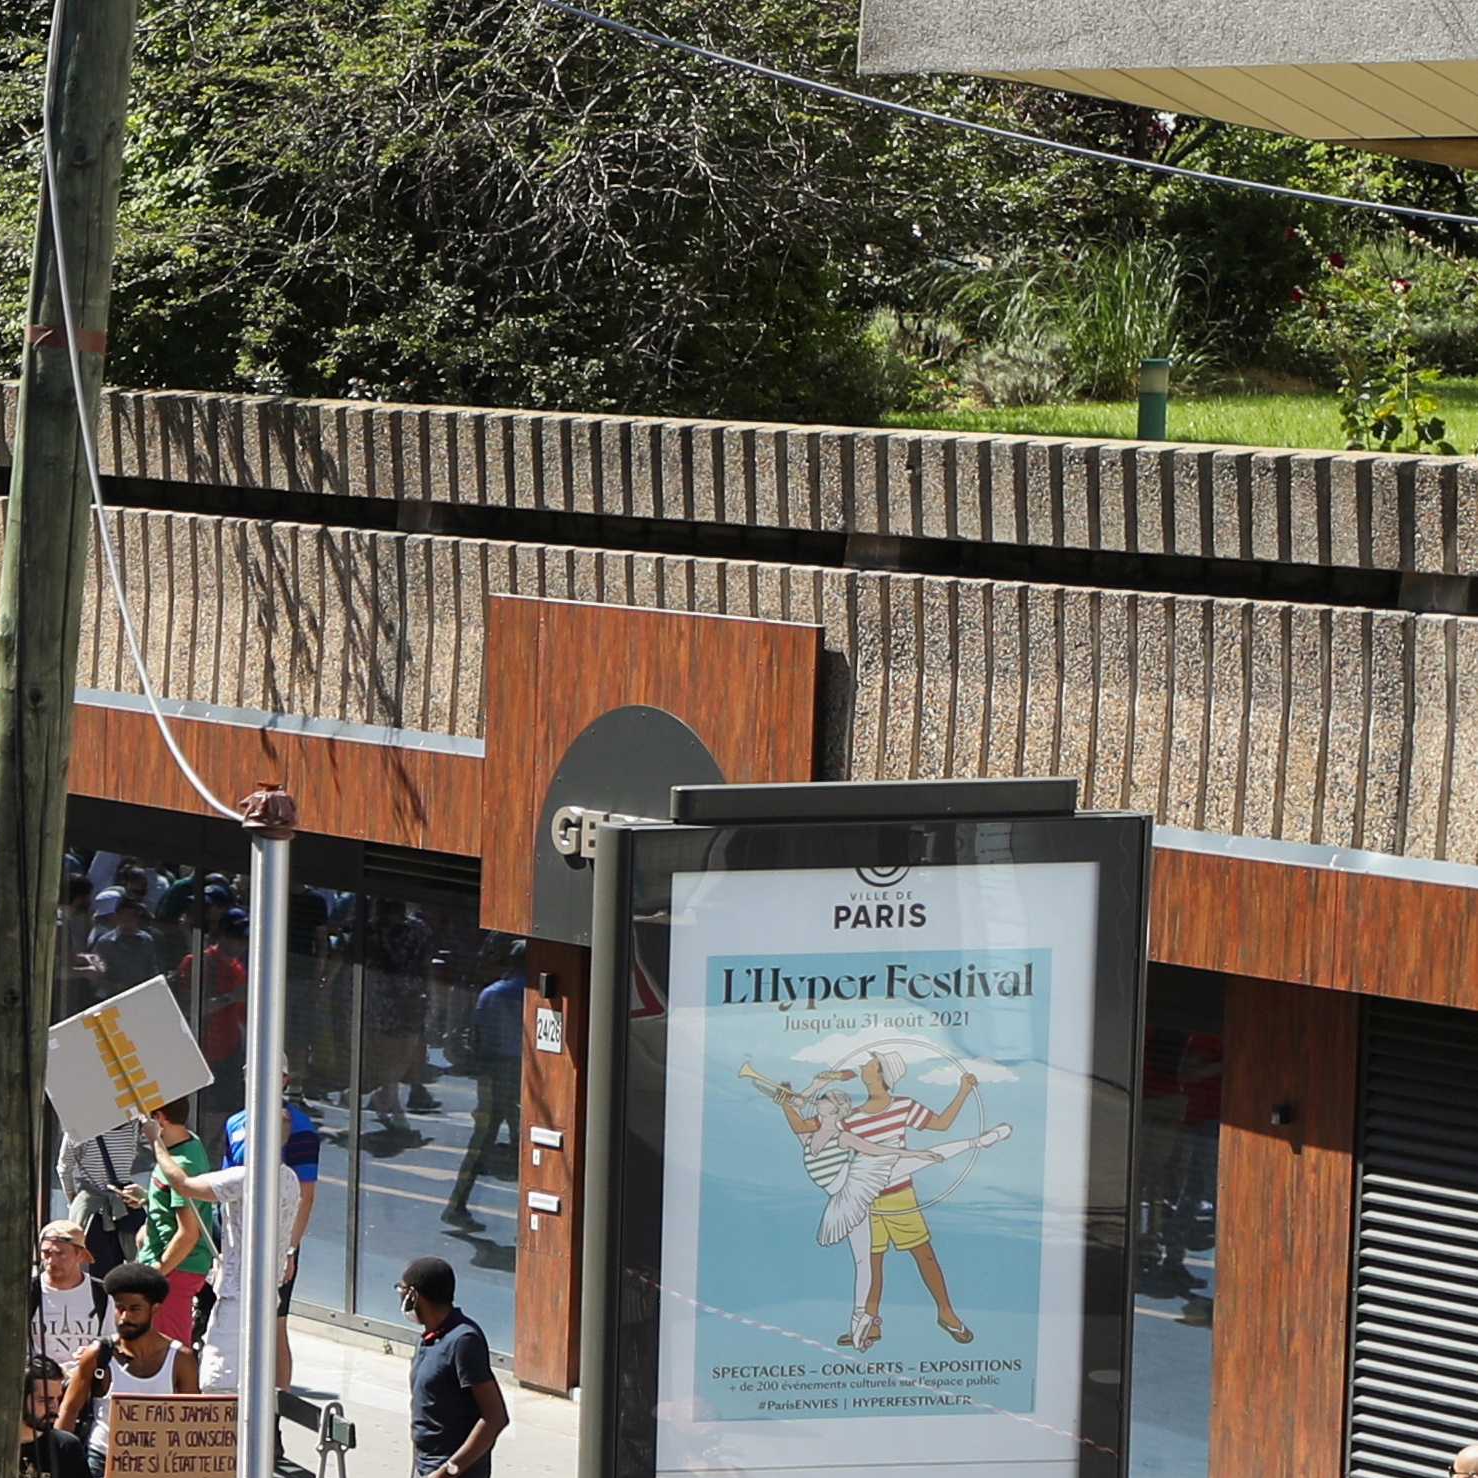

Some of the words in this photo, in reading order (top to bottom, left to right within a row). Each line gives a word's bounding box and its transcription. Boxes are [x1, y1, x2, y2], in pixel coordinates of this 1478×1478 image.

[850, 892, 889, 901] VILLE
[896, 891, 913, 900] DE
[833, 903, 927, 929] PARIS
[722, 967, 876, 1012] L'Hyper
[886, 962, 1034, 1001] Festival
[783, 1013, 857, 1033] Jusqu'au
[861, 1013, 879, 1028] 31
[884, 1012, 924, 1029] août
[929, 1011, 970, 1028] 2021
[712, 1364, 806, 1379] SPECTACLES
[821, 1361, 904, 1376] CONCERTS
[919, 1358, 1022, 1373] EXPOSITIONS
[739, 1380, 754, 1392] de
[756, 1380, 779, 1392] 200
[781, 1378, 846, 1391] événements
[849, 1377, 897, 1389] culturels
[899, 1379, 918, 1388] sur
[919, 1375, 964, 1390] l'espace
[966, 1374, 1000, 1389] public
[757, 1398, 838, 1411] #ParisENVIES
[852, 1395, 972, 1408] HYPERFESTIVAL.FR
[114, 1430, 156, 1447] CONTRE
[166, 1430, 180, 1447] TA
[112, 1450, 145, 1472] MÊME
[197, 1456, 211, 1472] TE
[213, 1455, 228, 1472] LE
